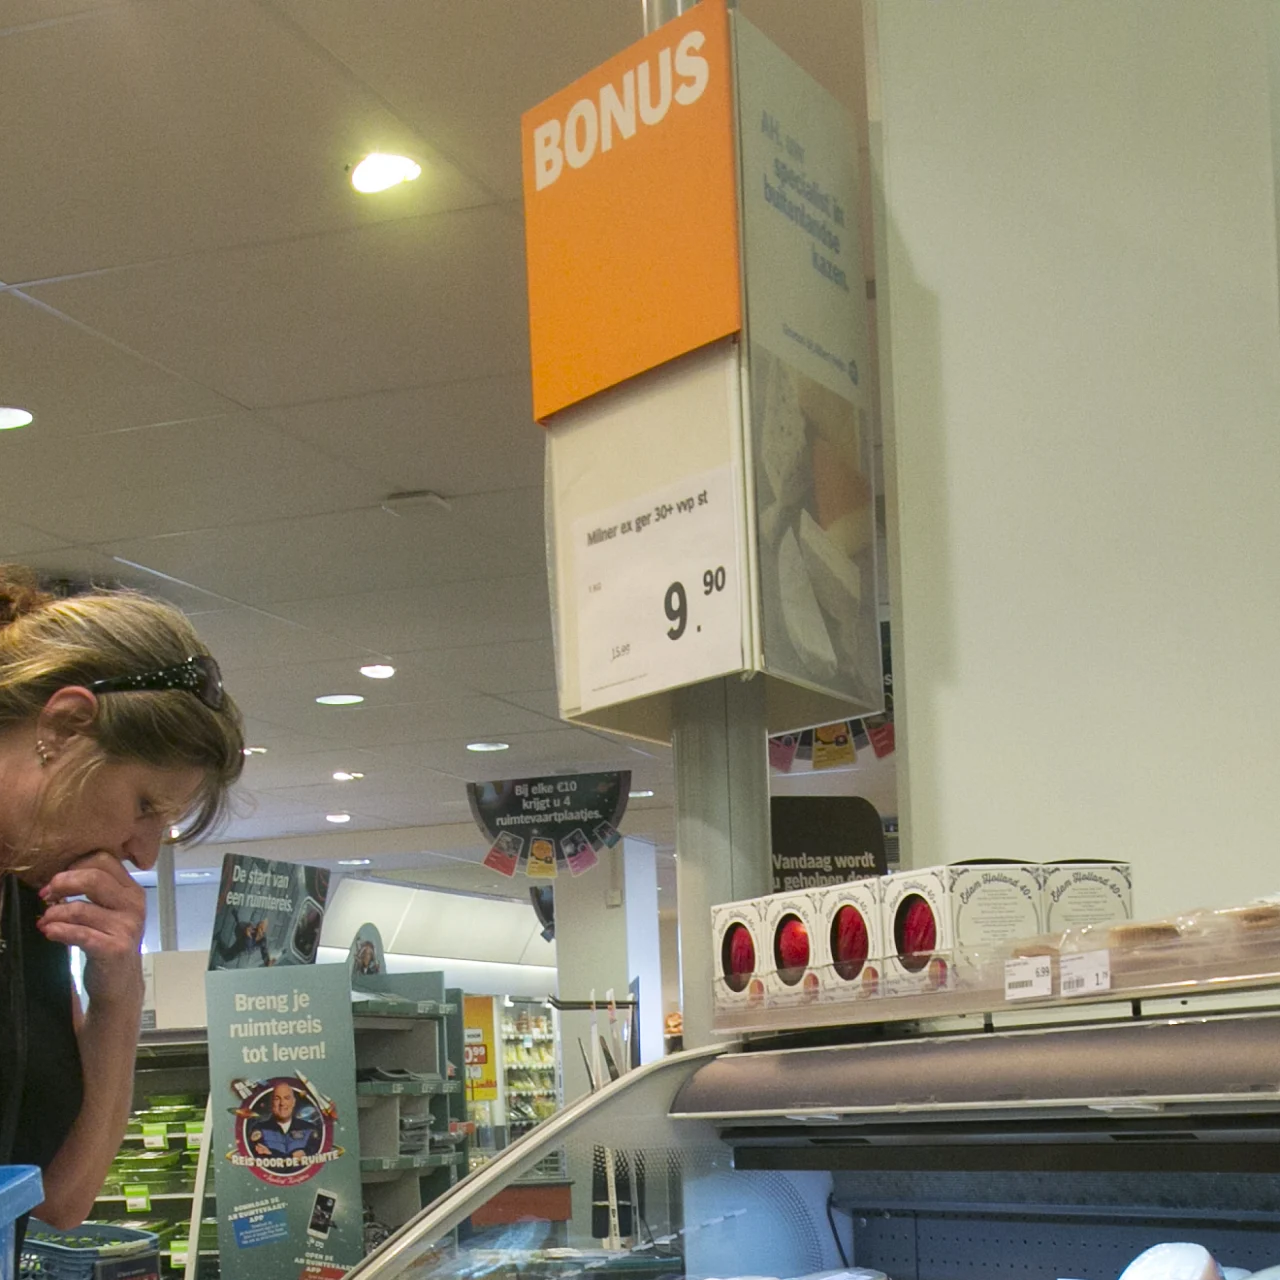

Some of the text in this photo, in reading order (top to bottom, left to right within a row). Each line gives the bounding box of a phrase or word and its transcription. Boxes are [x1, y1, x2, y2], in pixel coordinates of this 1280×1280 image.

[534, 30, 709, 192] BONUS
[587, 525, 618, 547] Milner
[620, 521, 633, 535] ex
[635, 513, 652, 533] ger
[654, 505, 674, 522] 30+
[697, 489, 709, 506] st
[515, 781, 578, 797] Bij elke €10
[522, 798, 551, 811] krijgt
[563, 796, 571, 806] 4
[496, 809, 602, 826] ruimtevaartplaatjes.
[773, 851, 876, 872] Vandaag wordt
[232, 865, 290, 889] De start van
[960, 880, 982, 905] Edam
[981, 872, 1020, 888] Holland
[1050, 879, 1072, 904] Edam
[1072, 872, 1109, 886] Holland
[226, 890, 293, 912] een ruimtereis.
[234, 989, 310, 1013] Breng je
[229, 1015, 322, 1039] ruimtereis
[242, 1042, 326, 1063] tot leven!
[232, 1151, 340, 1168] REIS DOOR DE RUIMTE
[234, 1199, 270, 1212] DOWNLOAD
[249, 1215, 264, 1223] APP
[305, 1252, 334, 1262] OPEN DE
[306, 1266, 322, 1274] APP
